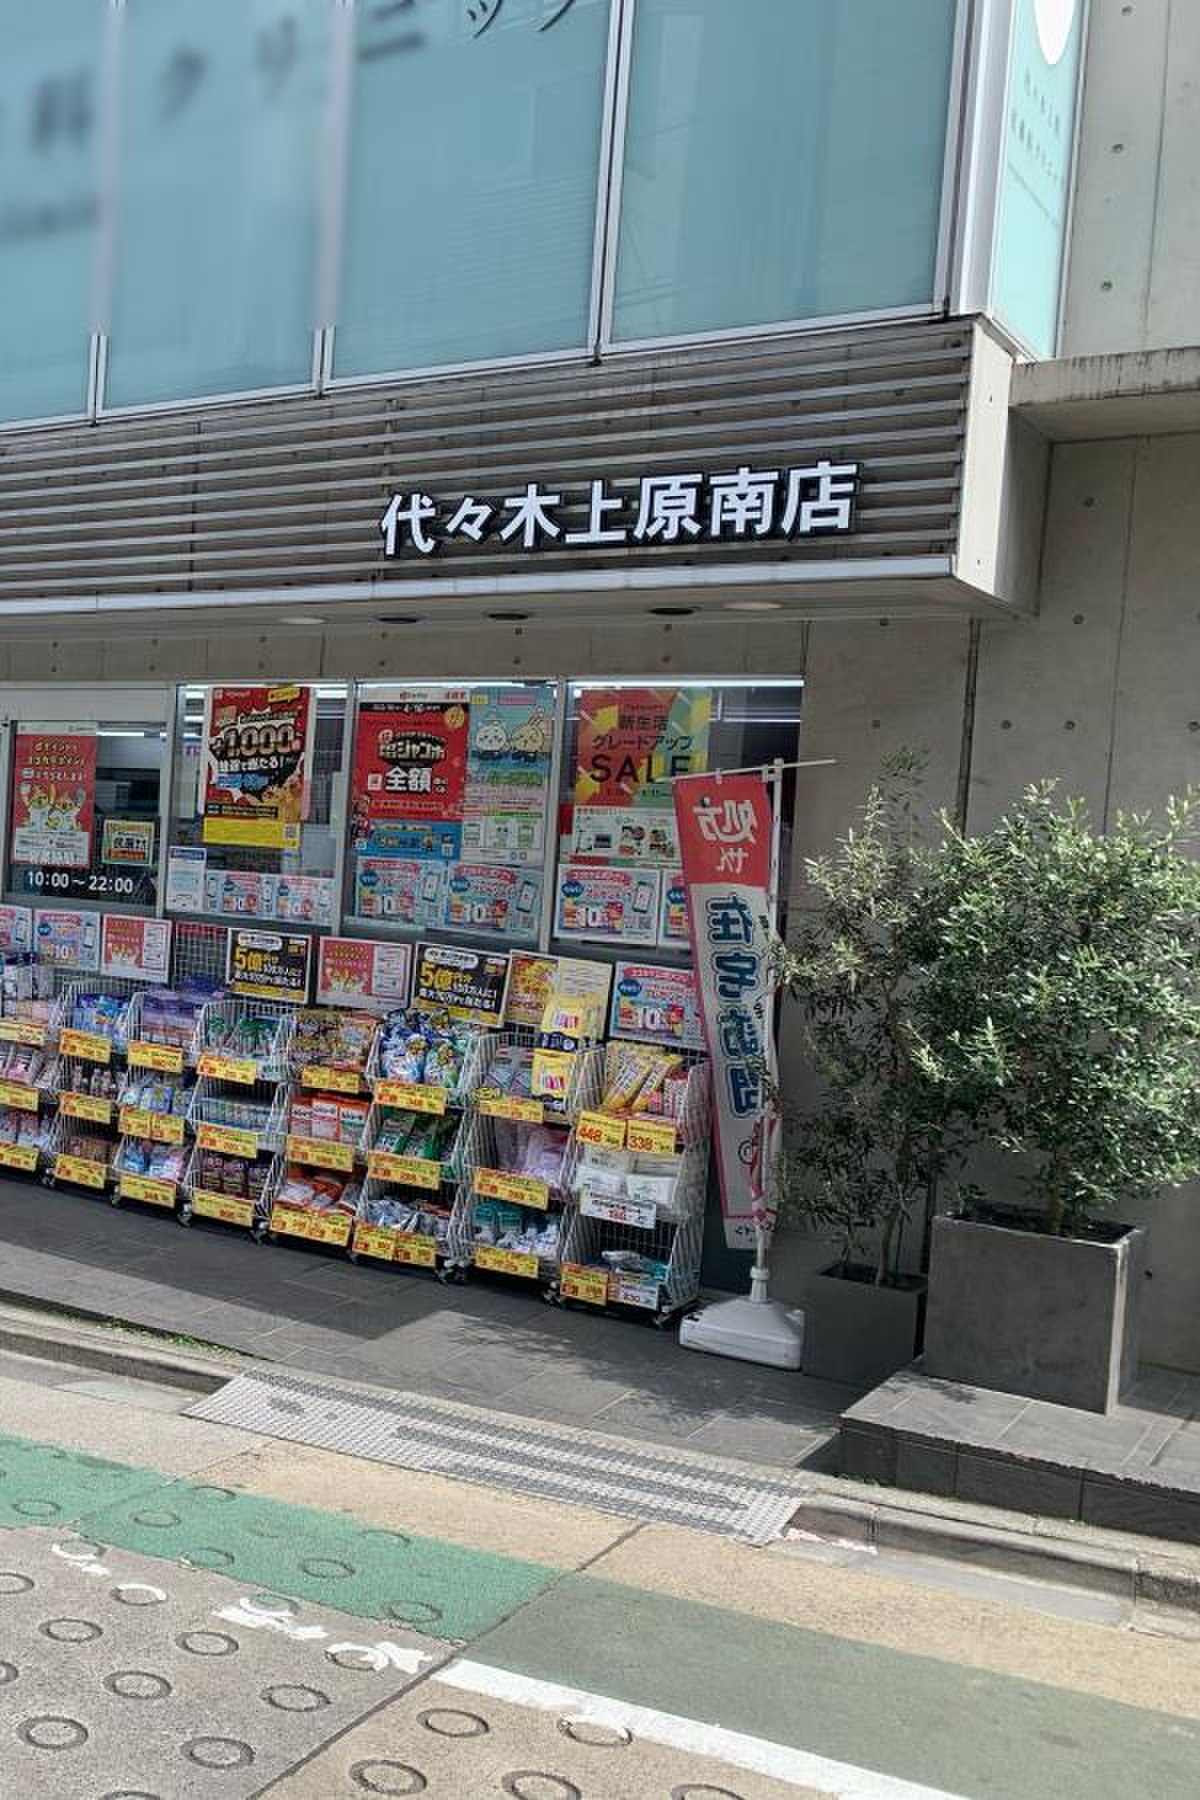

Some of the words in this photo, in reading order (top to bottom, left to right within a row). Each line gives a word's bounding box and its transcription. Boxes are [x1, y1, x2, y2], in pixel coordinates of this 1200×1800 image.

[382, 461, 860, 556] 代々木上原南店
[591, 735, 693, 752] グレードアップ
[385, 766, 432, 793] 全額
[590, 755, 691, 783] SALE
[579, 1126, 603, 1143] 448
[628, 1135, 653, 1150] 338
